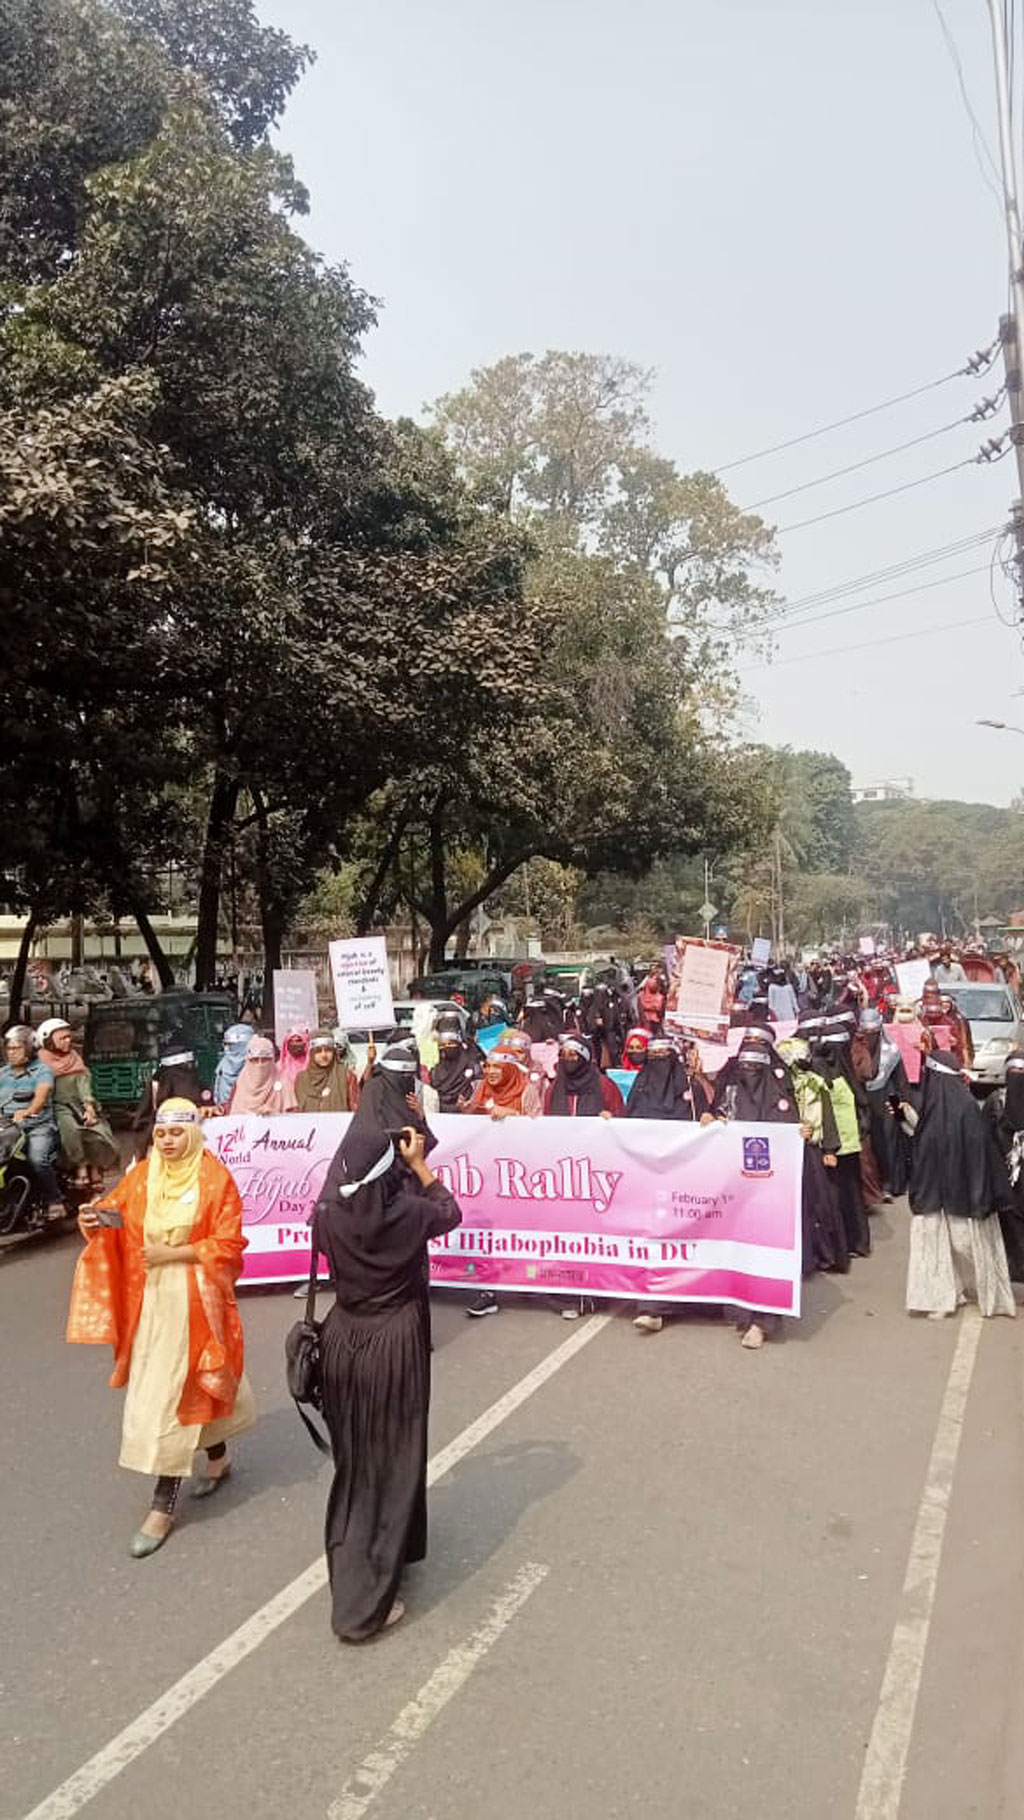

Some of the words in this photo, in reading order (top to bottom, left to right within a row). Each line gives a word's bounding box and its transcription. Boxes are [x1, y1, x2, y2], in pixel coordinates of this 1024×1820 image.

[216, 1125, 245, 1153] 12th
[252, 1128, 316, 1152] Annual
[495, 1156, 624, 1214] Rally
[279, 1200, 306, 1215] Day
[671, 1191, 719, 1206] February
[704, 1210, 723, 1219] am
[459, 1231, 619, 1258] Hijabophobia
[628, 1240, 649, 1260] in
[661, 1243, 697, 1261] DU
